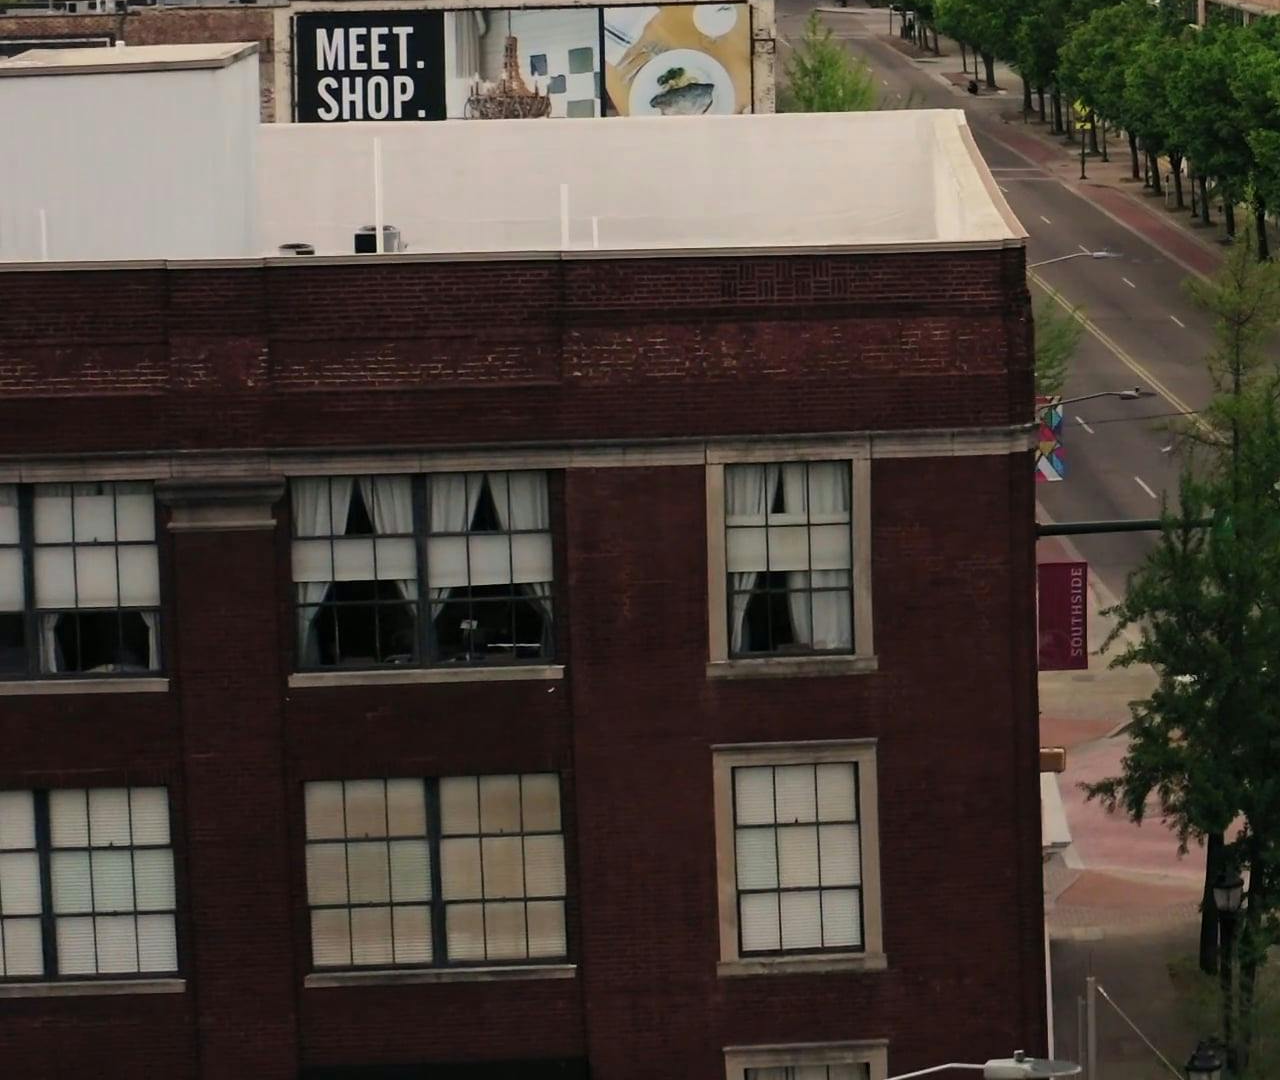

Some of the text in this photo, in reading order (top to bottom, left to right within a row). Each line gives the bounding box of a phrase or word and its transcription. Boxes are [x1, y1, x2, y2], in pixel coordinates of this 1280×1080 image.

[315, 26, 425, 71] MEET.
[316, 75, 426, 121] SHOP.
[1070, 567, 1083, 657] SOUTHSIDE
